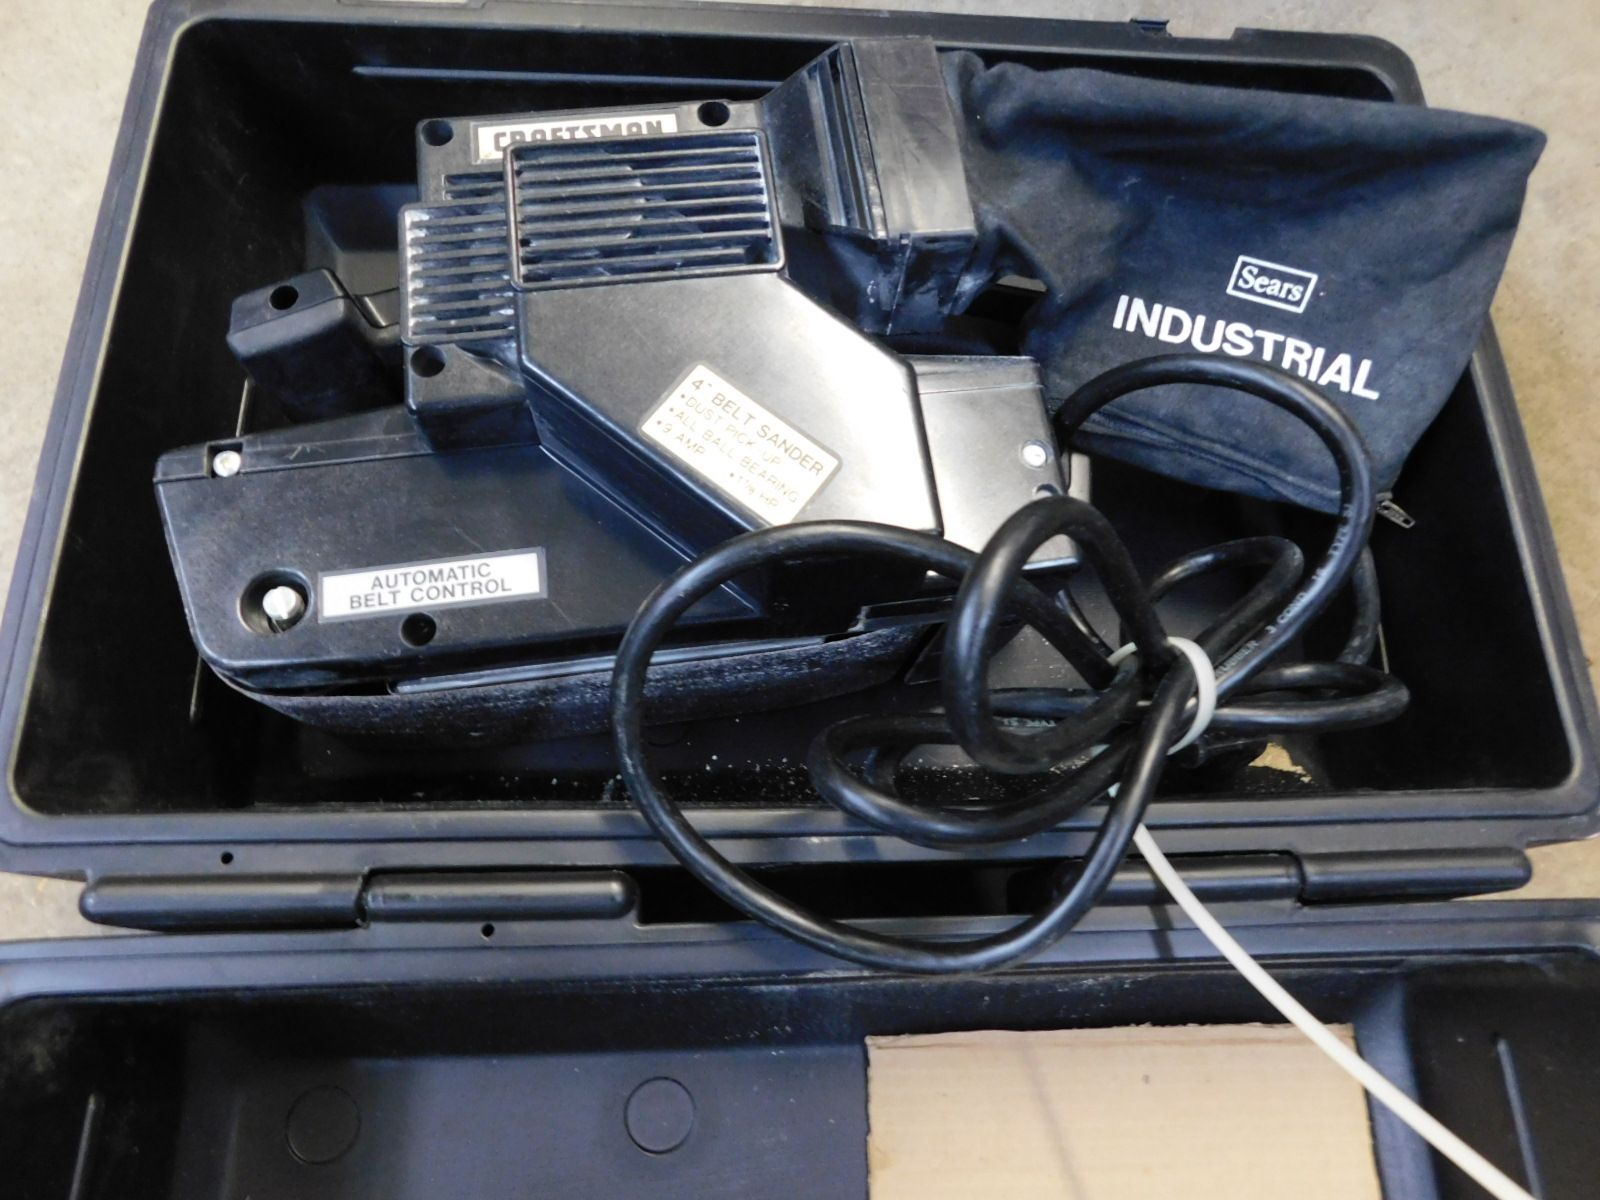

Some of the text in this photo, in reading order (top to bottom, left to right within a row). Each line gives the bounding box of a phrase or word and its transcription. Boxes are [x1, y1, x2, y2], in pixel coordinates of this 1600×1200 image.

[494, 120, 663, 152] CRAFTSMAN
[1238, 265, 1304, 302] Sears
[1112, 294, 1380, 401] INDUSTRIAL
[685, 396, 723, 425] DUST
[662, 423, 706, 456] 9 AMP
[711, 392, 756, 425] BELT
[756, 424, 824, 477] SANDER
[675, 411, 801, 504] ALL BALL BEARING
[759, 492, 779, 508] HP
[371, 562, 492, 590] AUTOMATIC
[349, 577, 512, 610] BELT CONTROL
